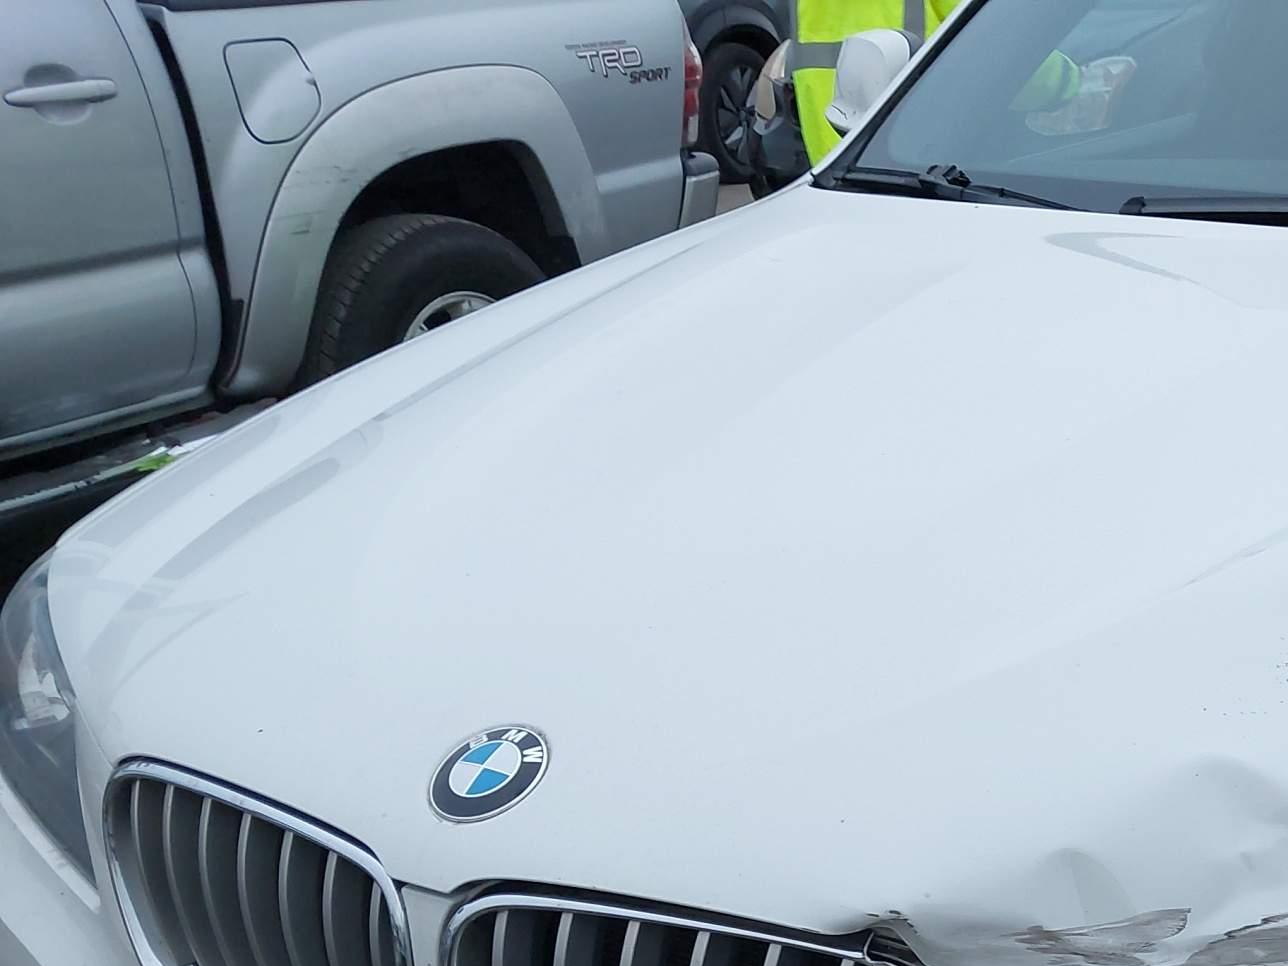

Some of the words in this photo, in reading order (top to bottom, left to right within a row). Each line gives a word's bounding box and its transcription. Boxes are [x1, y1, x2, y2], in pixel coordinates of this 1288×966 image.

[577, 46, 643, 77] TRD
[629, 67, 671, 84] SPORT
[469, 729, 543, 763] BMW
